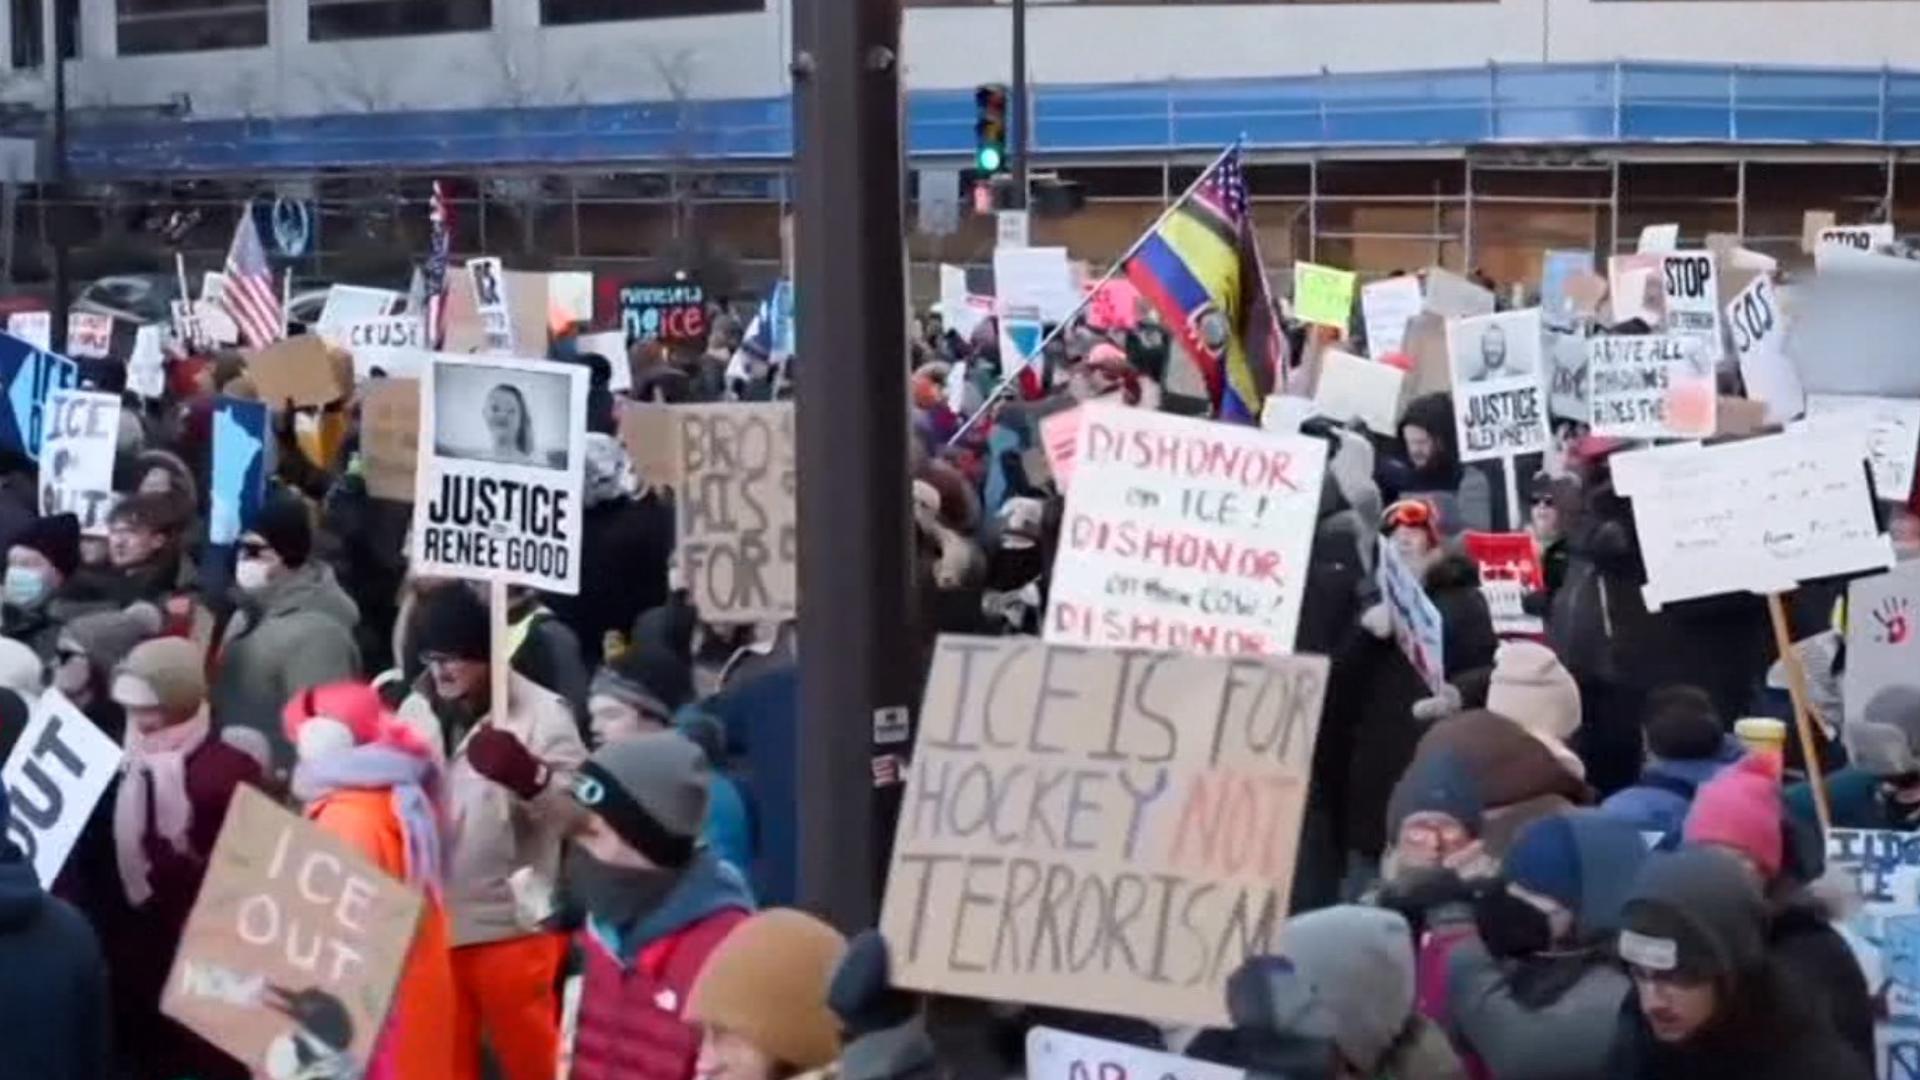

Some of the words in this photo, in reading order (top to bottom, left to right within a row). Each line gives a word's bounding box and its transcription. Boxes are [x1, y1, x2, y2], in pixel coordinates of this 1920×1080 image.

[1664, 256, 1711, 298] STOP
[1649, 338, 1684, 361] ALL
[1734, 281, 1773, 352] SOS
[47, 395, 116, 441] ICE
[1464, 387, 1540, 428] JUSTICE
[1087, 422, 1299, 491] DISHONOR
[429, 474, 570, 541] JUSTICE
[425, 529, 499, 568] RENEE
[507, 539, 569, 580] GOOD
[684, 530, 770, 609] FOR
[1071, 514, 1286, 586] DISHONOR
[1055, 603, 1273, 654] DISHONOR
[927, 643, 1086, 756] ICE
[1088, 649, 1180, 764] IS
[1209, 658, 1318, 769] FOR
[911, 759, 1170, 860] HOCKEY
[1169, 772, 1300, 878] NOT
[267, 824, 379, 934] ICE
[236, 893, 364, 982] OUT
[900, 852, 1281, 990] TERRORISM
